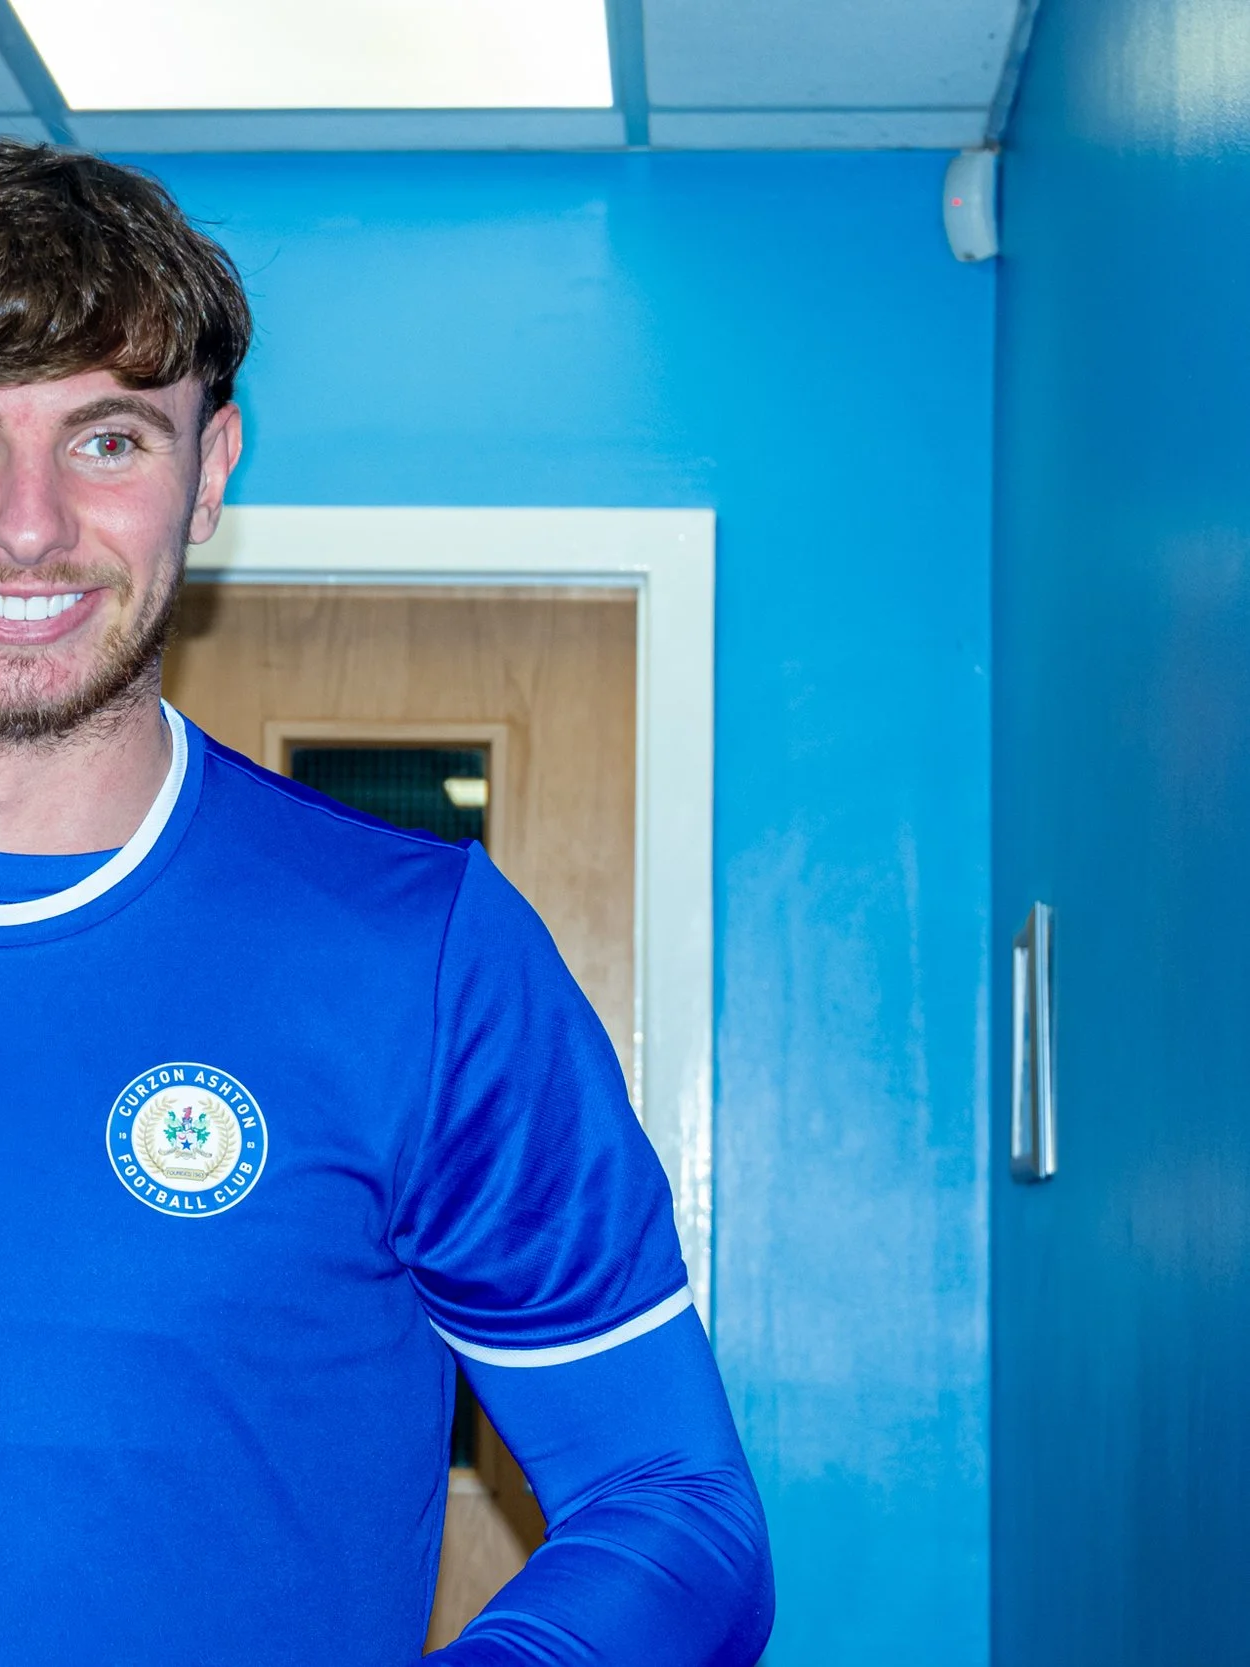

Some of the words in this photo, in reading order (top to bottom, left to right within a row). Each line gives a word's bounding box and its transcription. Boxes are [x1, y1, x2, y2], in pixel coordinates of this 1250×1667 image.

[119, 1069, 185, 1117] CURZON
[194, 1071, 256, 1129] ASHTON
[118, 1154, 207, 1210] FOOTBALL
[214, 1161, 253, 1203] CLUB
